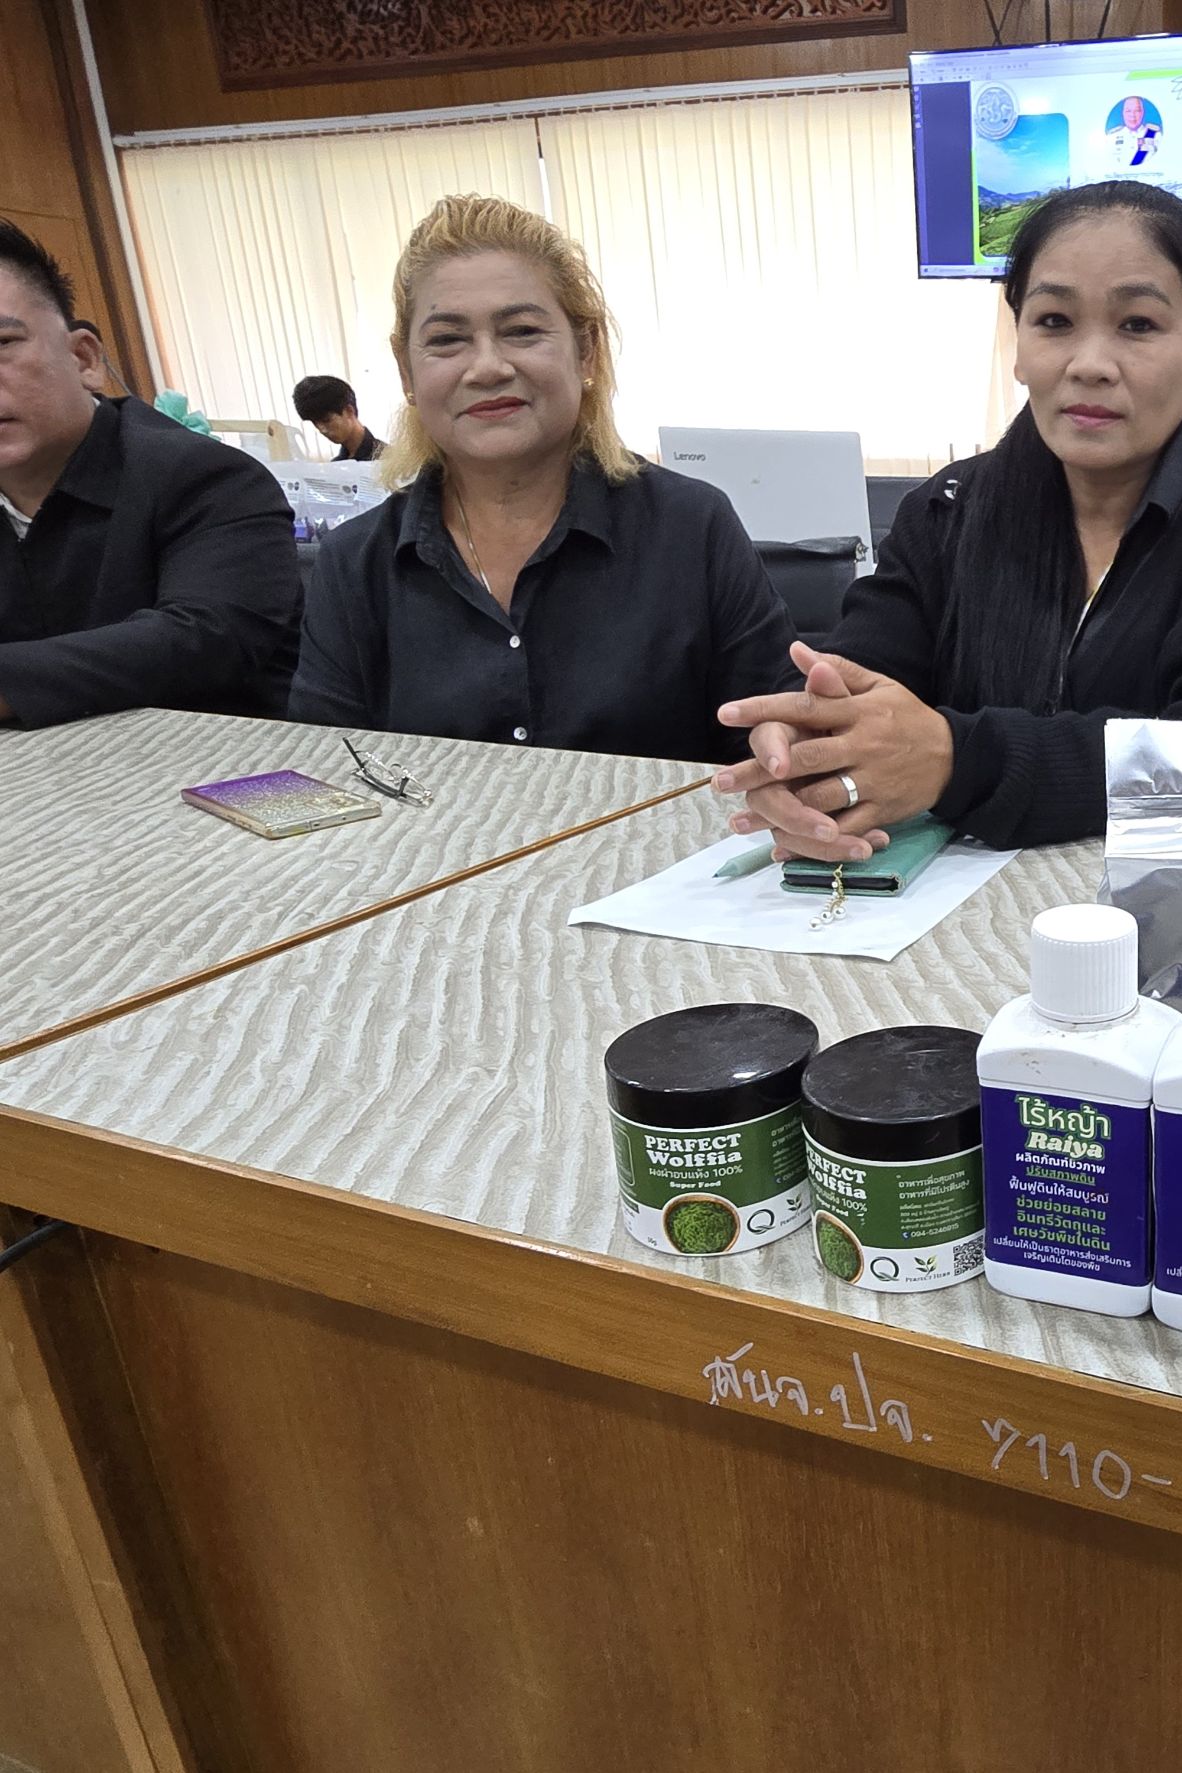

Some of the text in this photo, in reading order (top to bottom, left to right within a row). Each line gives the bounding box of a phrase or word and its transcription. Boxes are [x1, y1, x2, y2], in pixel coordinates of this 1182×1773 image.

[673, 451, 706, 462] Lenovo
[1018, 1097, 1109, 1139] ไร้หญ้า
[644, 1133, 742, 1153] PERFECT
[1028, 1131, 1103, 1158] Raiya
[646, 1149, 743, 1168] Wolffia
[712, 1164, 744, 1178] 100%
[669, 1180, 722, 1190] Super Food
[1009, 1179, 1109, 1204] ฟื้นฟูดินให้สมบูรณ์
[842, 1198, 868, 1212] 100%
[1016, 1194, 1107, 1221] ช่วยย่อยสลาย
